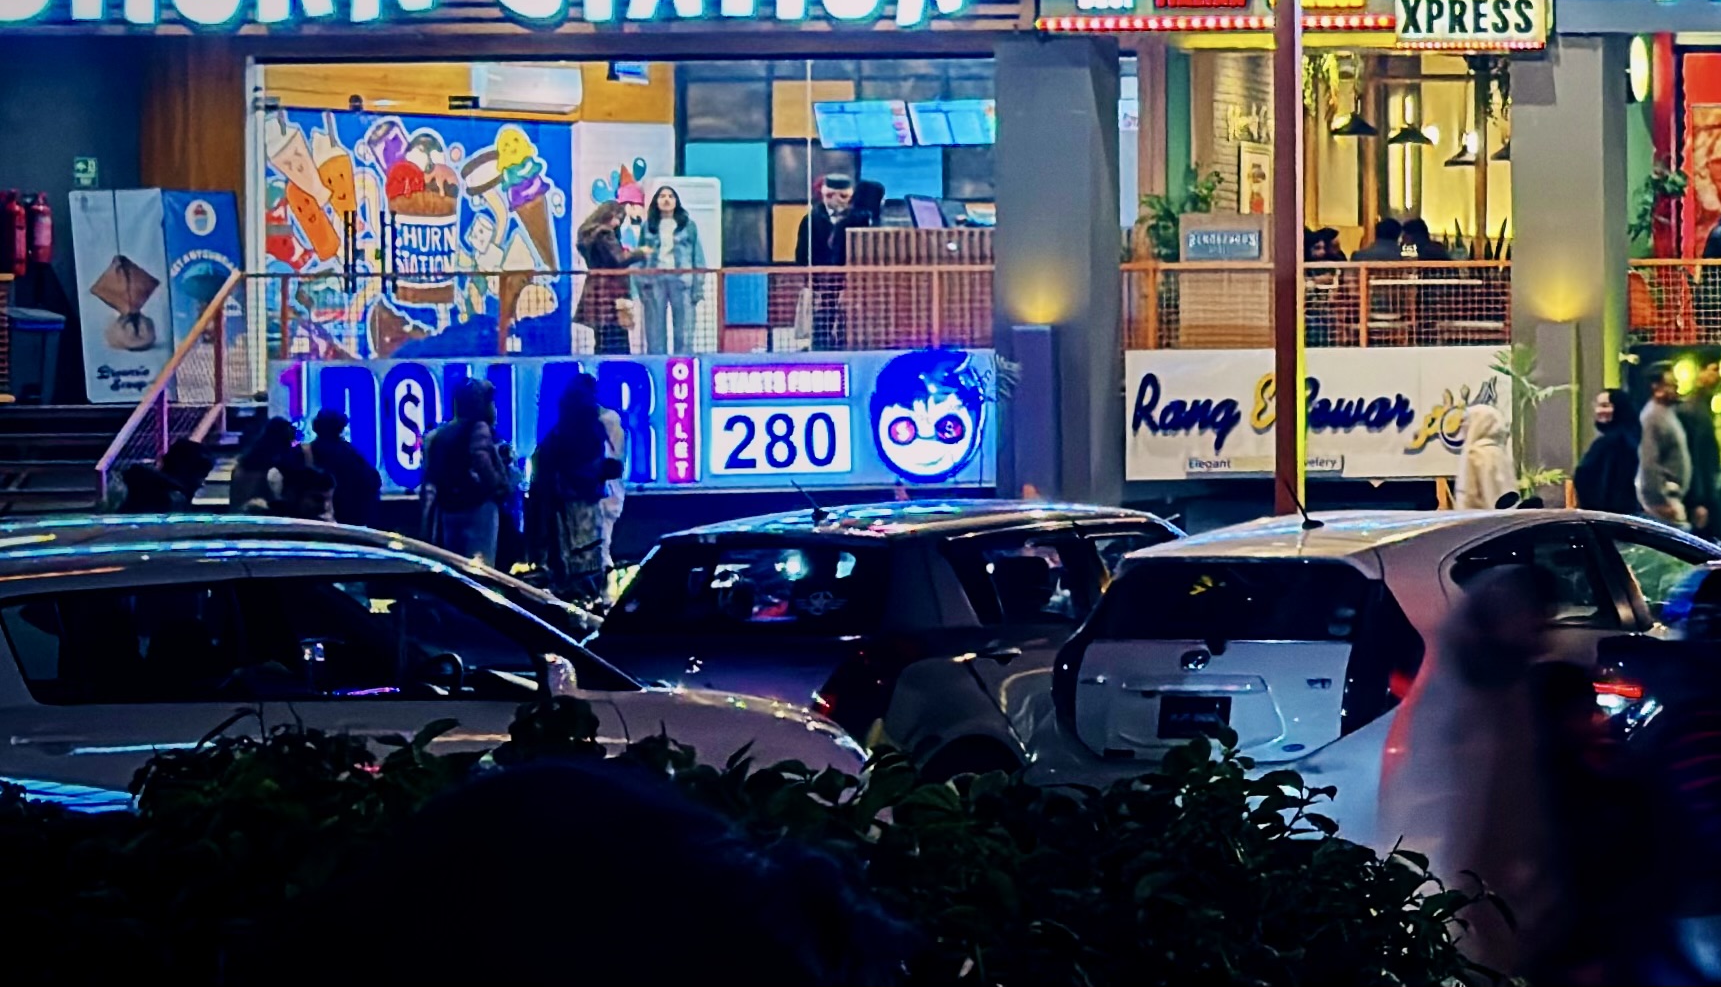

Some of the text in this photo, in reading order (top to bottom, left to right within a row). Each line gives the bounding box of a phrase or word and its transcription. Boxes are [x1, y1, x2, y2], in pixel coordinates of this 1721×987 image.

[671, 362, 692, 480] OUTLET
[723, 411, 837, 470] 280
[1133, 372, 1243, 454] Rang
